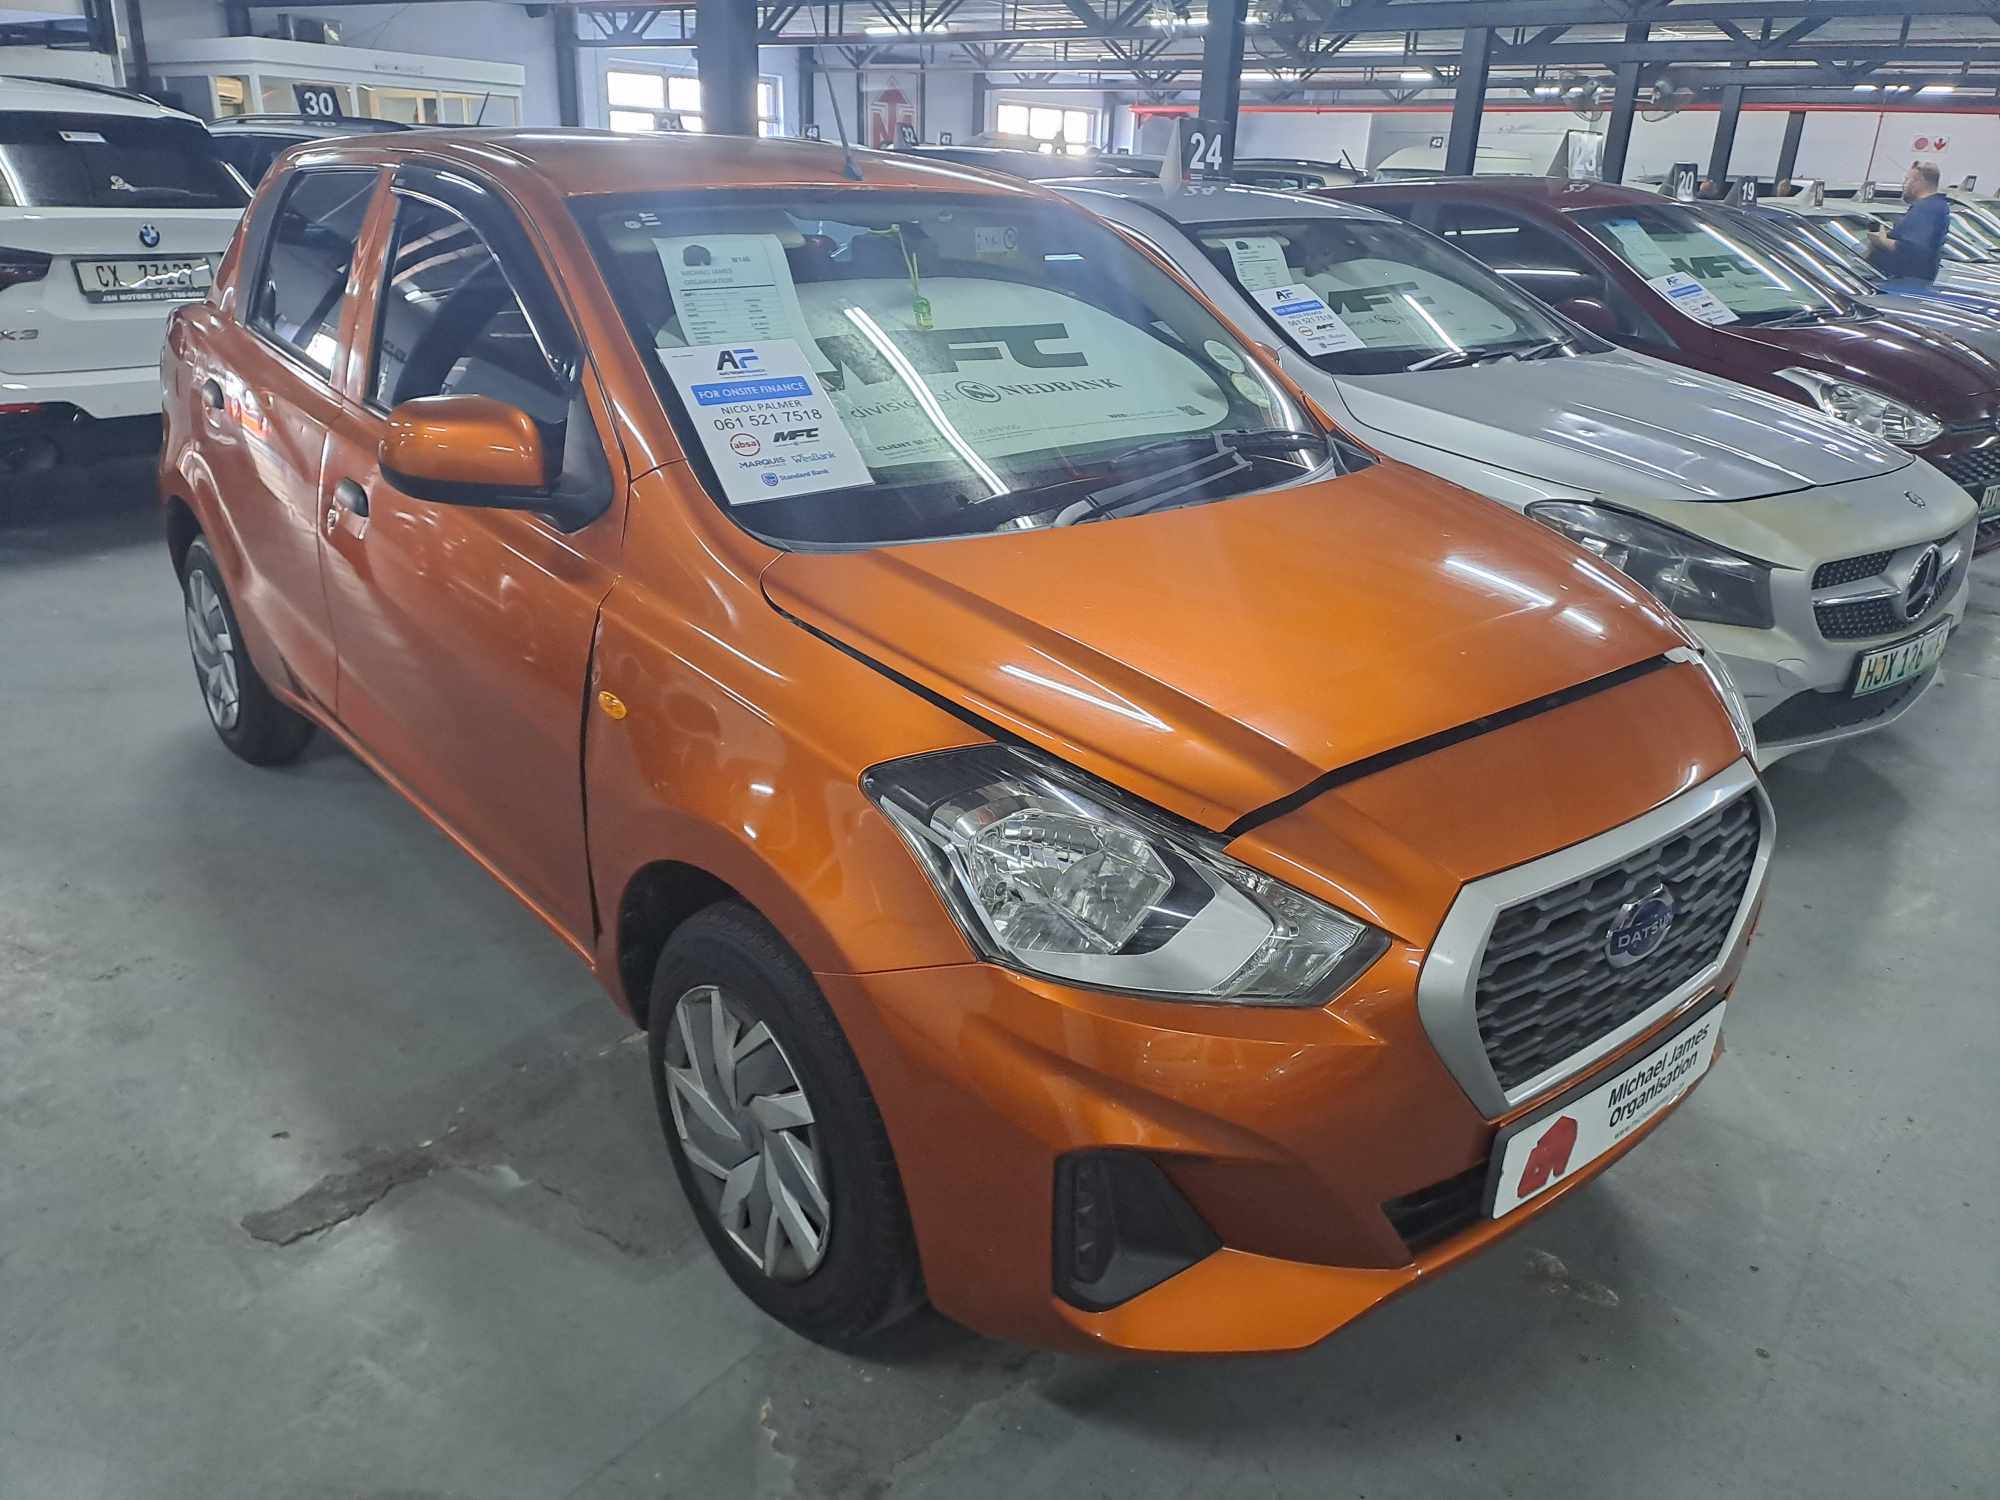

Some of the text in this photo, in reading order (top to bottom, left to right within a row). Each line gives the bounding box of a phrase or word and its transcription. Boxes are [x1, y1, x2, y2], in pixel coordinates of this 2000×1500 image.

[304, 92, 334, 115] 30
[902, 127, 917, 142] 32
[1189, 132, 1222, 170] 24
[1677, 171, 1694, 196] 20
[1742, 182, 1755, 200] 19
[96, 265, 121, 287] CX
[717, 349, 759, 371] AF
[815, 323, 1089, 392] MFC
[698, 382, 805, 400] FOR ONSITE FINANCE
[851, 396, 924, 418] divisio
[995, 379, 1122, 395] NEDBANK
[721, 400, 803, 415] NICOL PALMER
[714, 408, 822, 431] 061 521 7518
[734, 427, 818, 449] absa MFC
[739, 456, 786, 469] MARQUIS
[780, 469, 829, 481] Standard Bank
[1862, 650, 1898, 689] HJX
[1608, 1023, 1710, 1109] Michael James
[1609, 1051, 1699, 1128] Organisation
